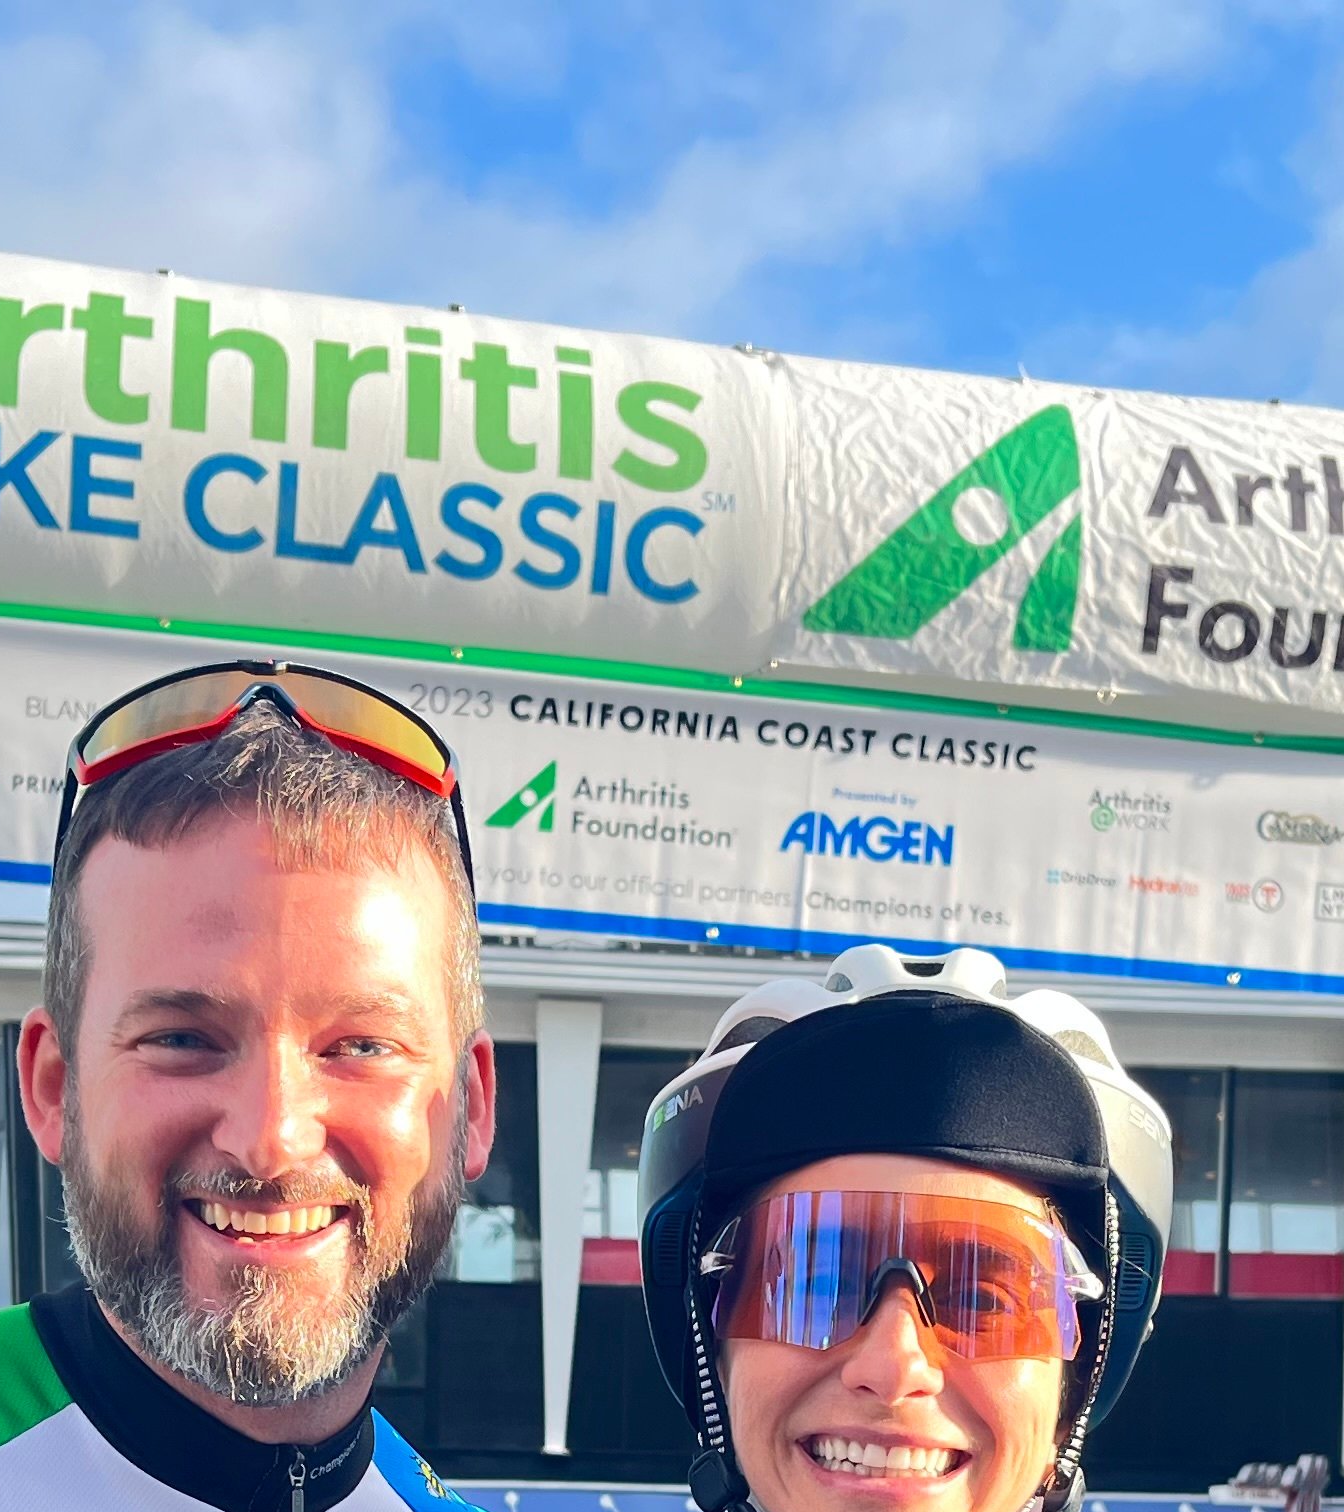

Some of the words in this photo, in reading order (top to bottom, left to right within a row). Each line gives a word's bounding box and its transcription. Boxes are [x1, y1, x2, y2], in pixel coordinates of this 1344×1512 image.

[183, 452, 706, 605] CLASSIC
[408, 683, 494, 719] 2023
[509, 694, 739, 743] CALIFORNIA
[757, 719, 877, 756] COAST
[891, 732, 1038, 772] CLASSIC
[572, 776, 691, 810] Arthritis
[1089, 789, 1171, 814] Arthritis
[571, 811, 731, 848] Foundation
[779, 810, 955, 868] AMGEN
[487, 864, 532, 887] you
[539, 865, 562, 888] to
[568, 872, 606, 892] our
[613, 872, 693, 900] official
[805, 889, 933, 922] Champions
[939, 901, 964, 921] of
